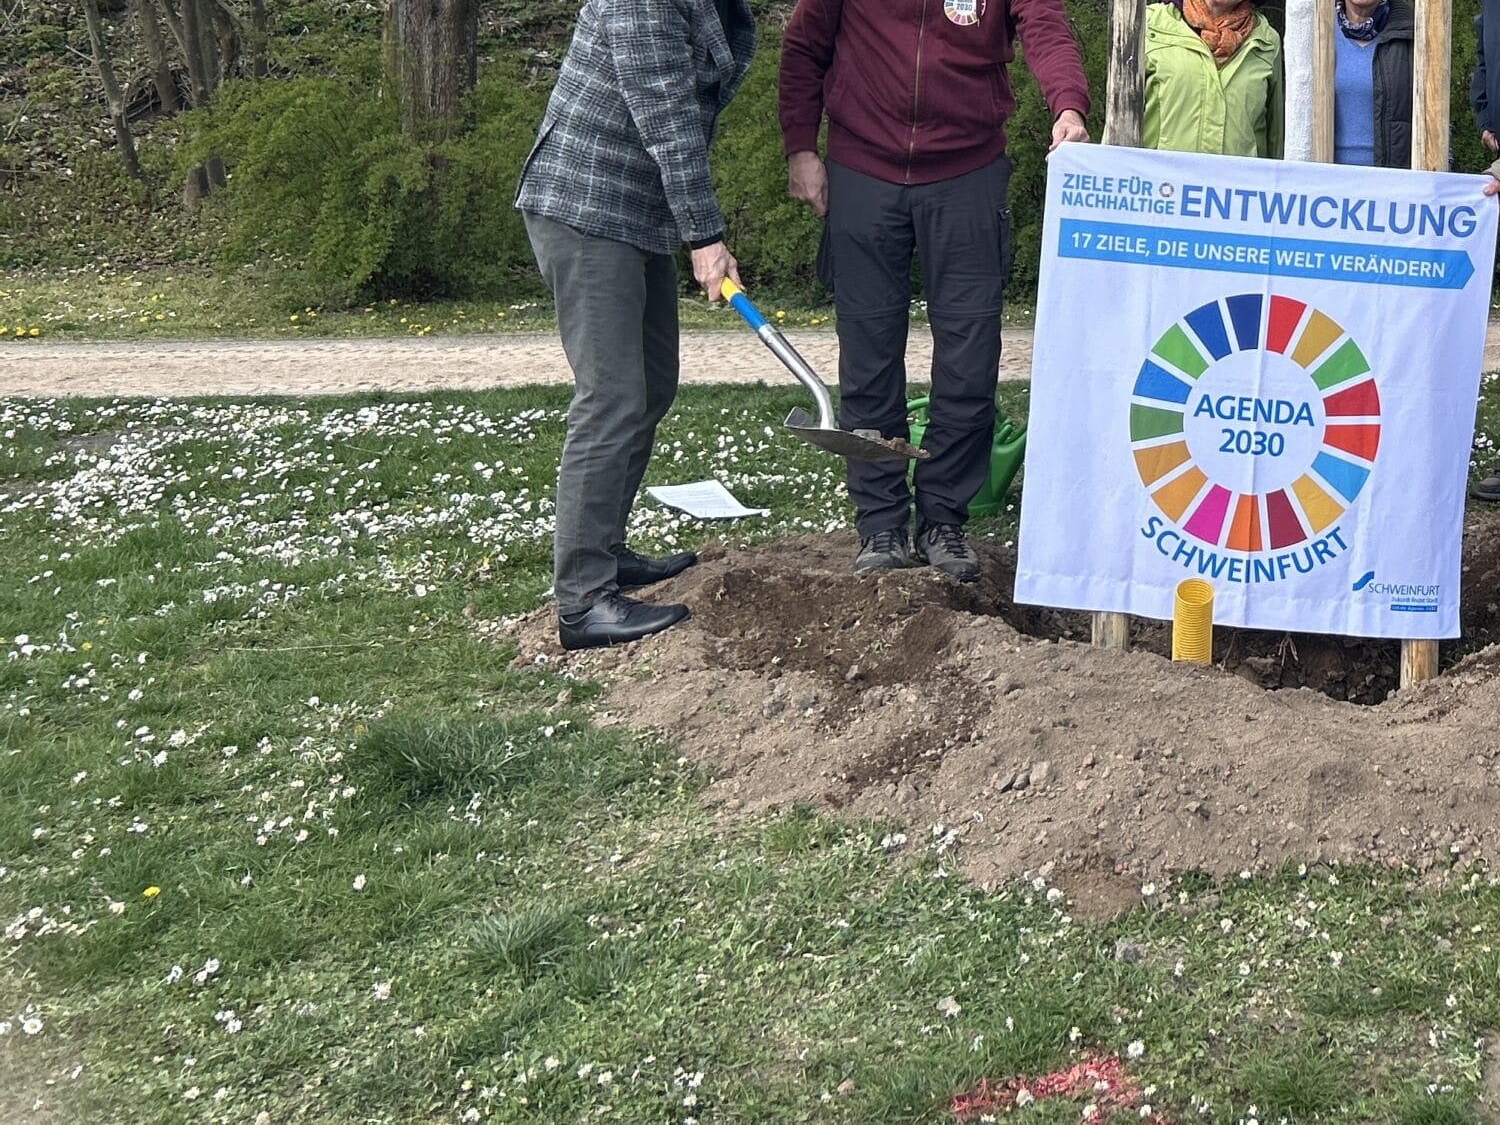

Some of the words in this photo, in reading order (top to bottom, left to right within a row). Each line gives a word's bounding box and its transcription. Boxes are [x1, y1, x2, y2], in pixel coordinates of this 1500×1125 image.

[956, 3, 973, 12] 2030
[1062, 173, 1114, 193] ZIELE
[1118, 176, 1153, 197] FÜR
[1061, 191, 1175, 215] NACHHALTIGE
[1180, 184, 1477, 238] ENTWICKLUNG
[1071, 232, 1092, 248] 17
[1096, 234, 1150, 259] ZIELE,
[1156, 239, 1189, 257] DIE
[1193, 242, 1270, 265] UNSERE
[1275, 249, 1325, 269] WELT
[1330, 253, 1446, 279] VERÄNDERN
[1193, 394, 1315, 426] AGENDA
[1219, 428, 1285, 457] 2030
[1140, 516, 1348, 583] SCHWEINFURT
[1368, 582, 1441, 596] SCHWEINFURT
